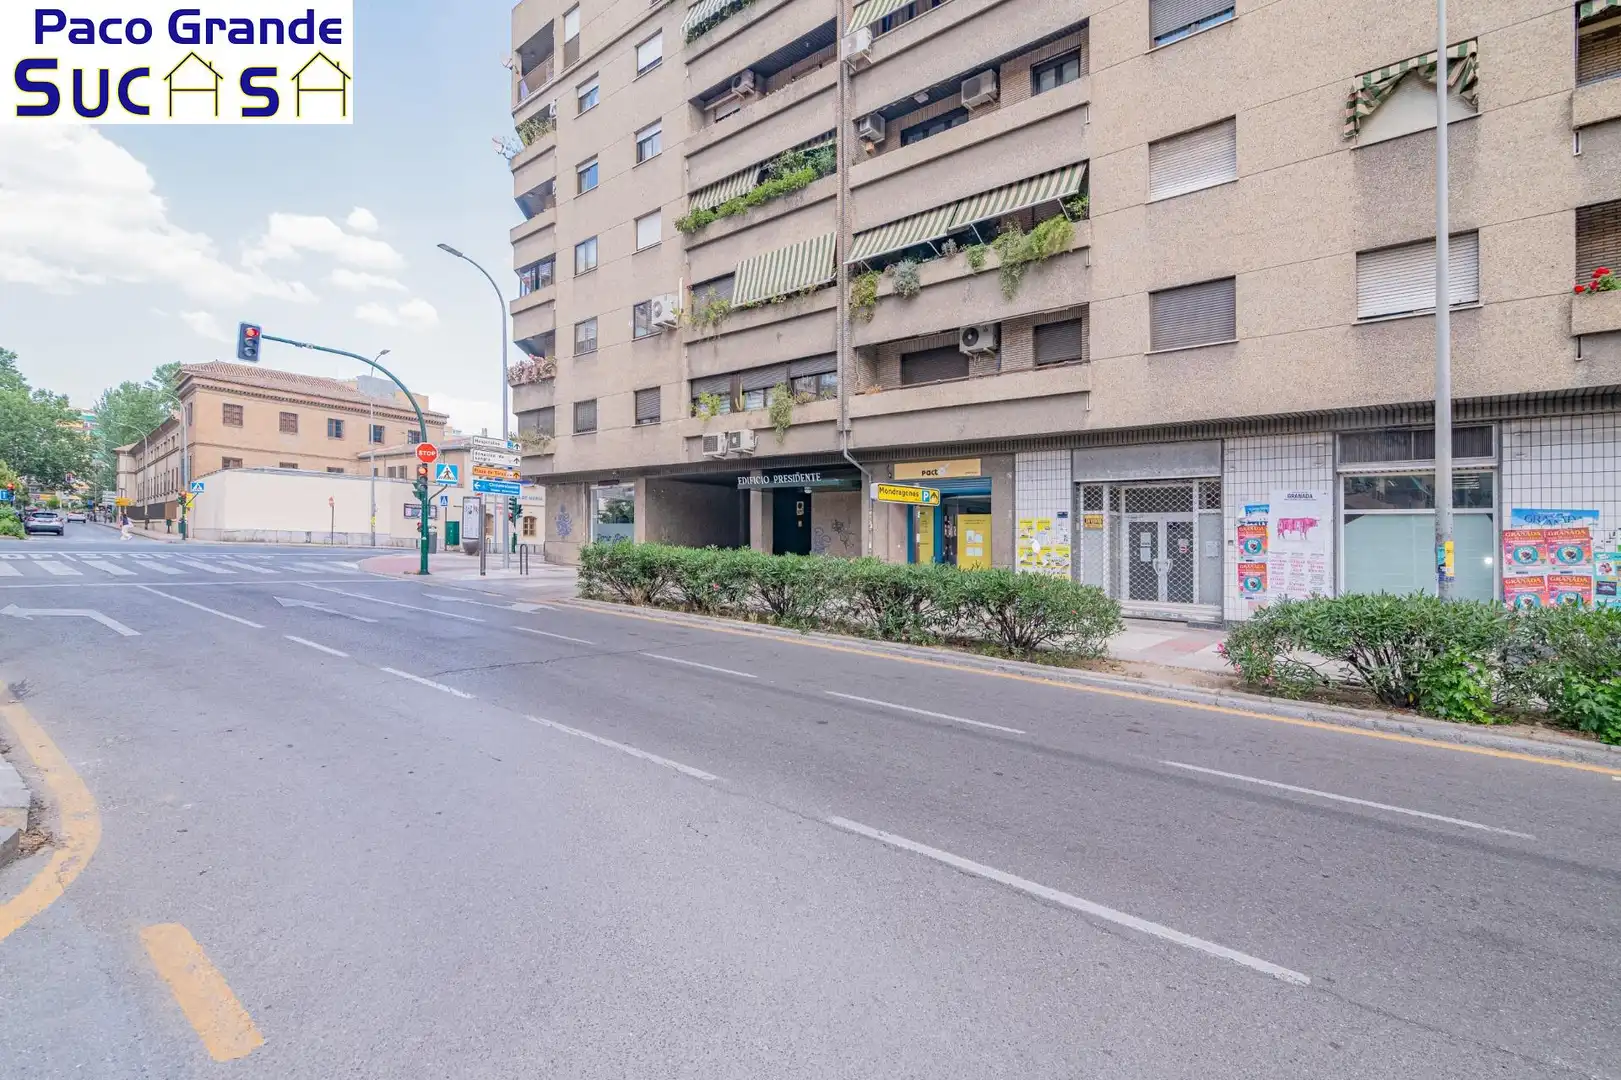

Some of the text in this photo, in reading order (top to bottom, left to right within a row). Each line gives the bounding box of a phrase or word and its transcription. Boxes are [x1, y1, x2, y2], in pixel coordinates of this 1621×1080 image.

[738, 472, 822, 485] EDIFICIO PRESIDENTE
[1548, 529, 1586, 538] GRANADA
[1505, 577, 1541, 585] GRANADA
[1550, 576, 1588, 584] GRANADA
